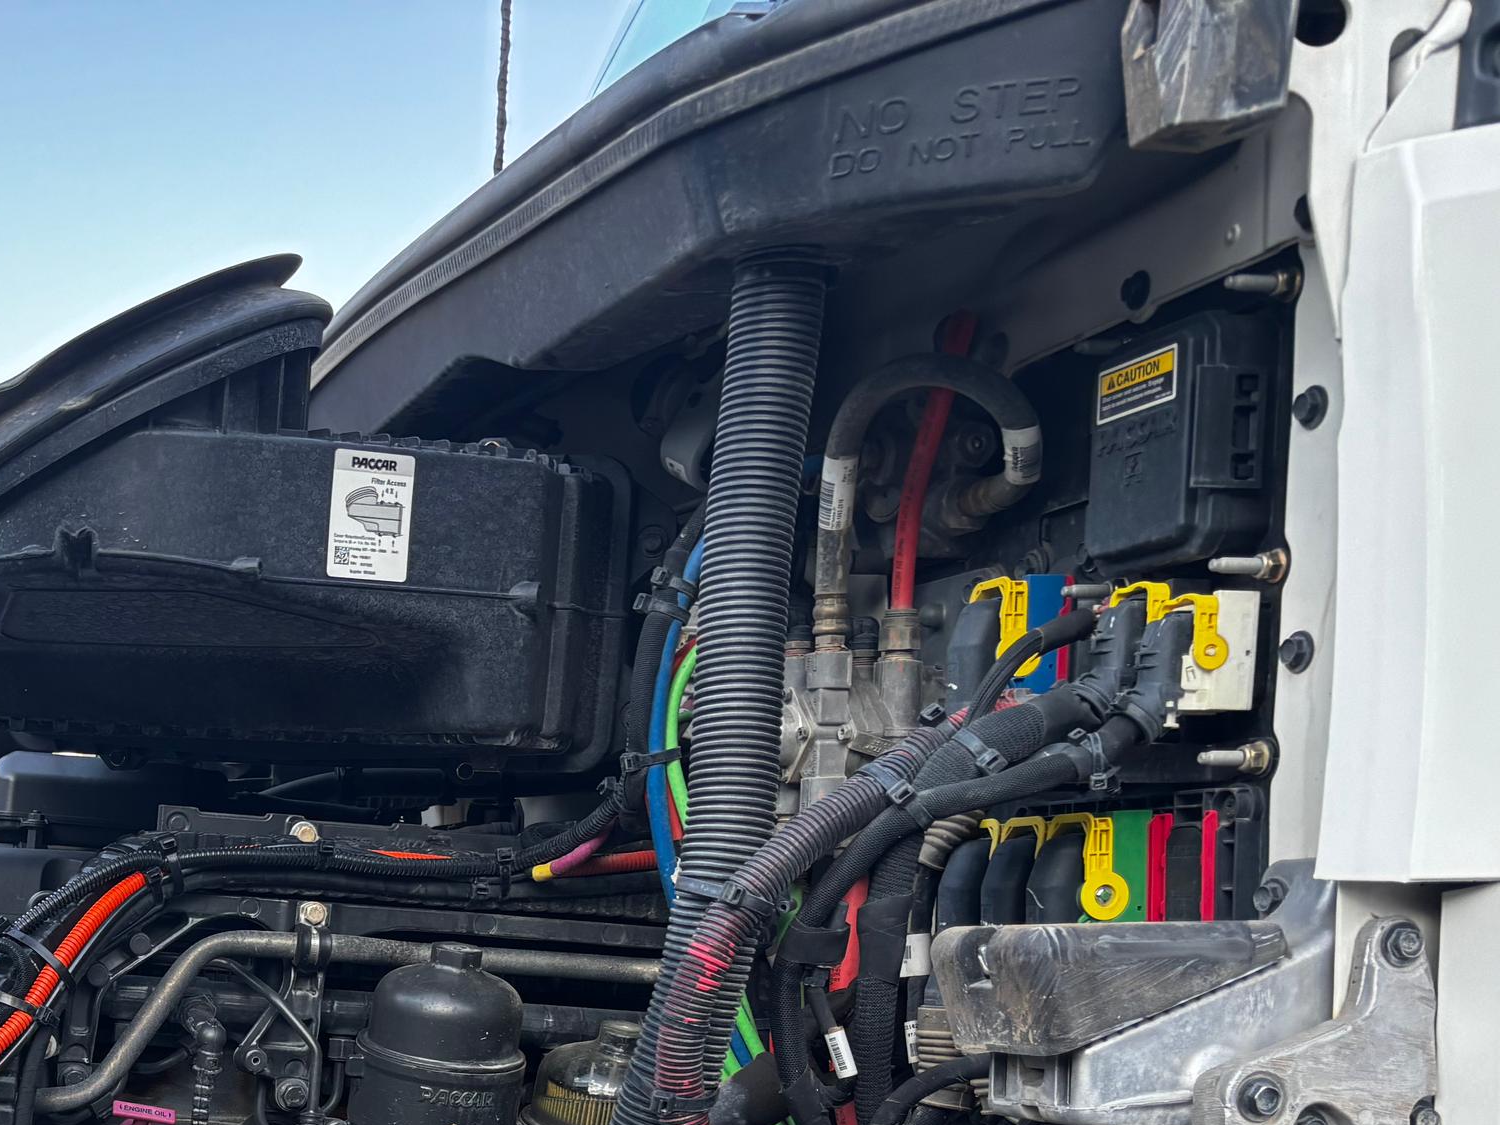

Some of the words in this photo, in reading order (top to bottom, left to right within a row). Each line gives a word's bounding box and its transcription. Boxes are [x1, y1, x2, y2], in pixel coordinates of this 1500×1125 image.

[833, 97, 910, 143] NO
[951, 77, 1081, 124] STEP
[829, 148, 881, 179] DO
[908, 133, 981, 166] NOT
[1005, 120, 1094, 154] PULL
[1117, 360, 1160, 386] CAUTION
[352, 456, 397, 471] PACCAR
[420, 1086, 494, 1107] PACCAR
[124, 1105, 152, 1114] ENGINE
